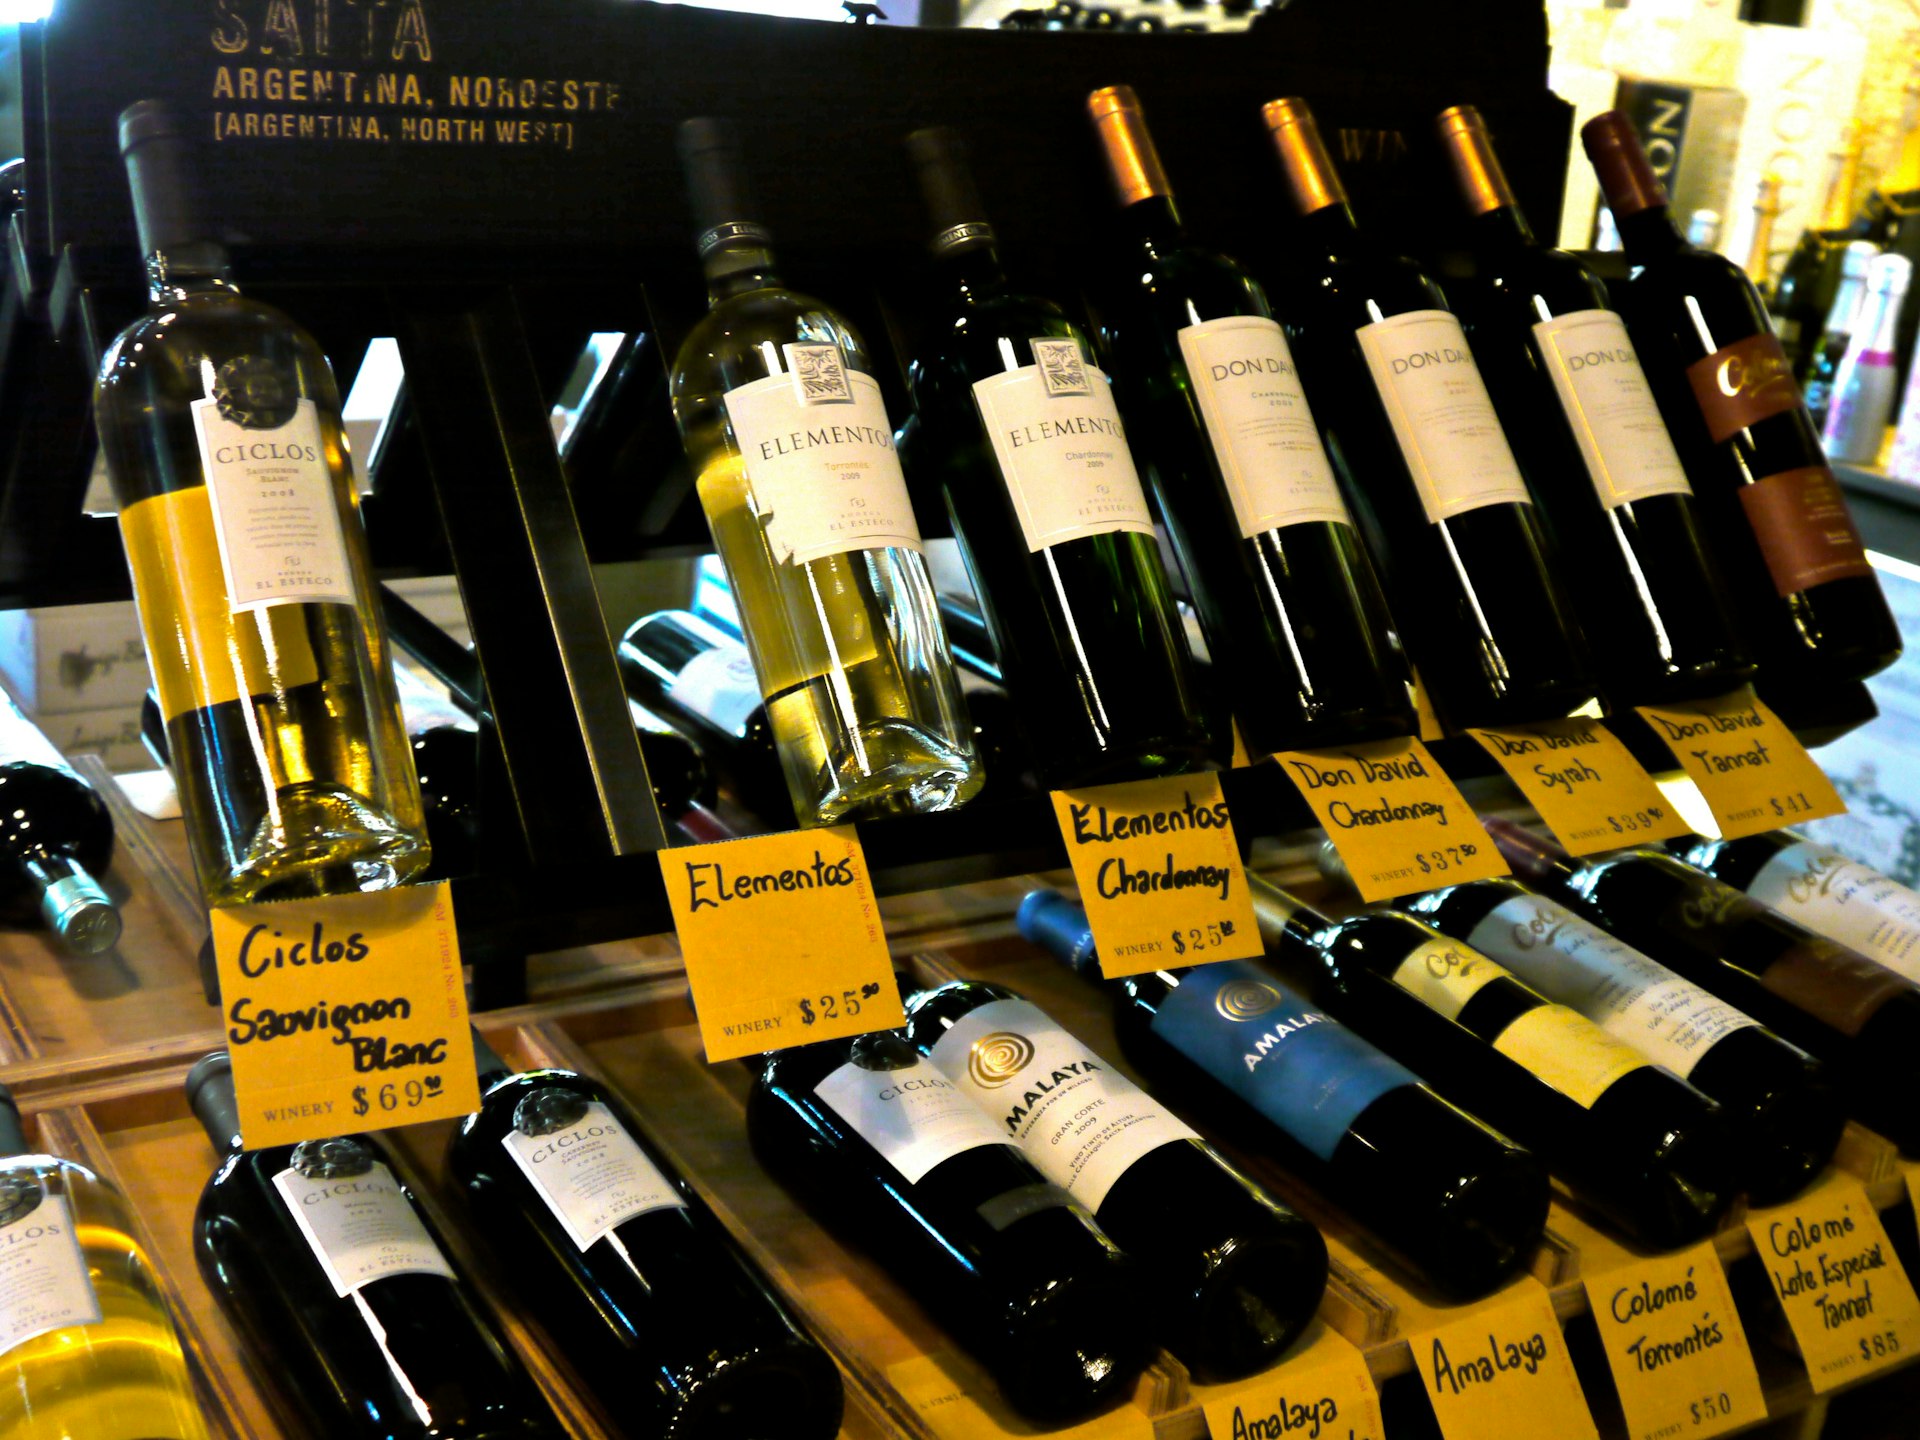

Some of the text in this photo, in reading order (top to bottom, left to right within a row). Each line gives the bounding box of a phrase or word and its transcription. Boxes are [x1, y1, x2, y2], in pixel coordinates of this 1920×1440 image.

[212, 66, 433, 107] ARGENTINA,
[401, 118, 484, 143] NORTH
[1211, 358, 1263, 382] DON
[1392, 351, 1441, 374] DON
[1569, 351, 1614, 371] DON
[216, 443, 317, 465] CICLOS
[1652, 707, 1764, 741] Don David
[1482, 731, 1539, 756] Don
[1692, 739, 1772, 775] Tannat
[1289, 752, 1429, 788] Don David
[1534, 758, 1602, 794] Syrah
[1070, 790, 1230, 844] Elementos
[1329, 797, 1447, 829] Chardonnay
[1771, 794, 1814, 818] $41
[685, 850, 854, 912] Elementos
[1097, 853, 1230, 901] Chardonnay
[1371, 867, 1415, 883] WINERY
[239, 921, 369, 978] Ciclos
[1113, 941, 1164, 957] WINERY
[723, 1016, 783, 1037] WINERY
[349, 1036, 448, 1073] Blanc
[263, 1100, 335, 1123] WINERY
[1005, 1061, 1102, 1138] MALAYA
[1051, 1098, 1106, 1146] GRAN CORTE
[1074, 1117, 1098, 1137] 2009
[532, 1125, 618, 1164] CICLOS
[1069, 1151, 1085, 1169] VINO
[1082, 1133, 1102, 1154] TINTO
[1110, 1114, 1136, 1128] ALTURA
[1775, 1243, 1887, 1300] Lote Especial
[1612, 1266, 1698, 1325] Colomé
[1815, 1280, 1875, 1330] Tannat
[1627, 1312, 1723, 1373] Torrontés
[1859, 1330, 1899, 1362] $85
[1432, 1333, 1547, 1394] Amalaya
[1233, 1397, 1338, 1440] Amalaya
[1690, 1392, 1731, 1426] $50
